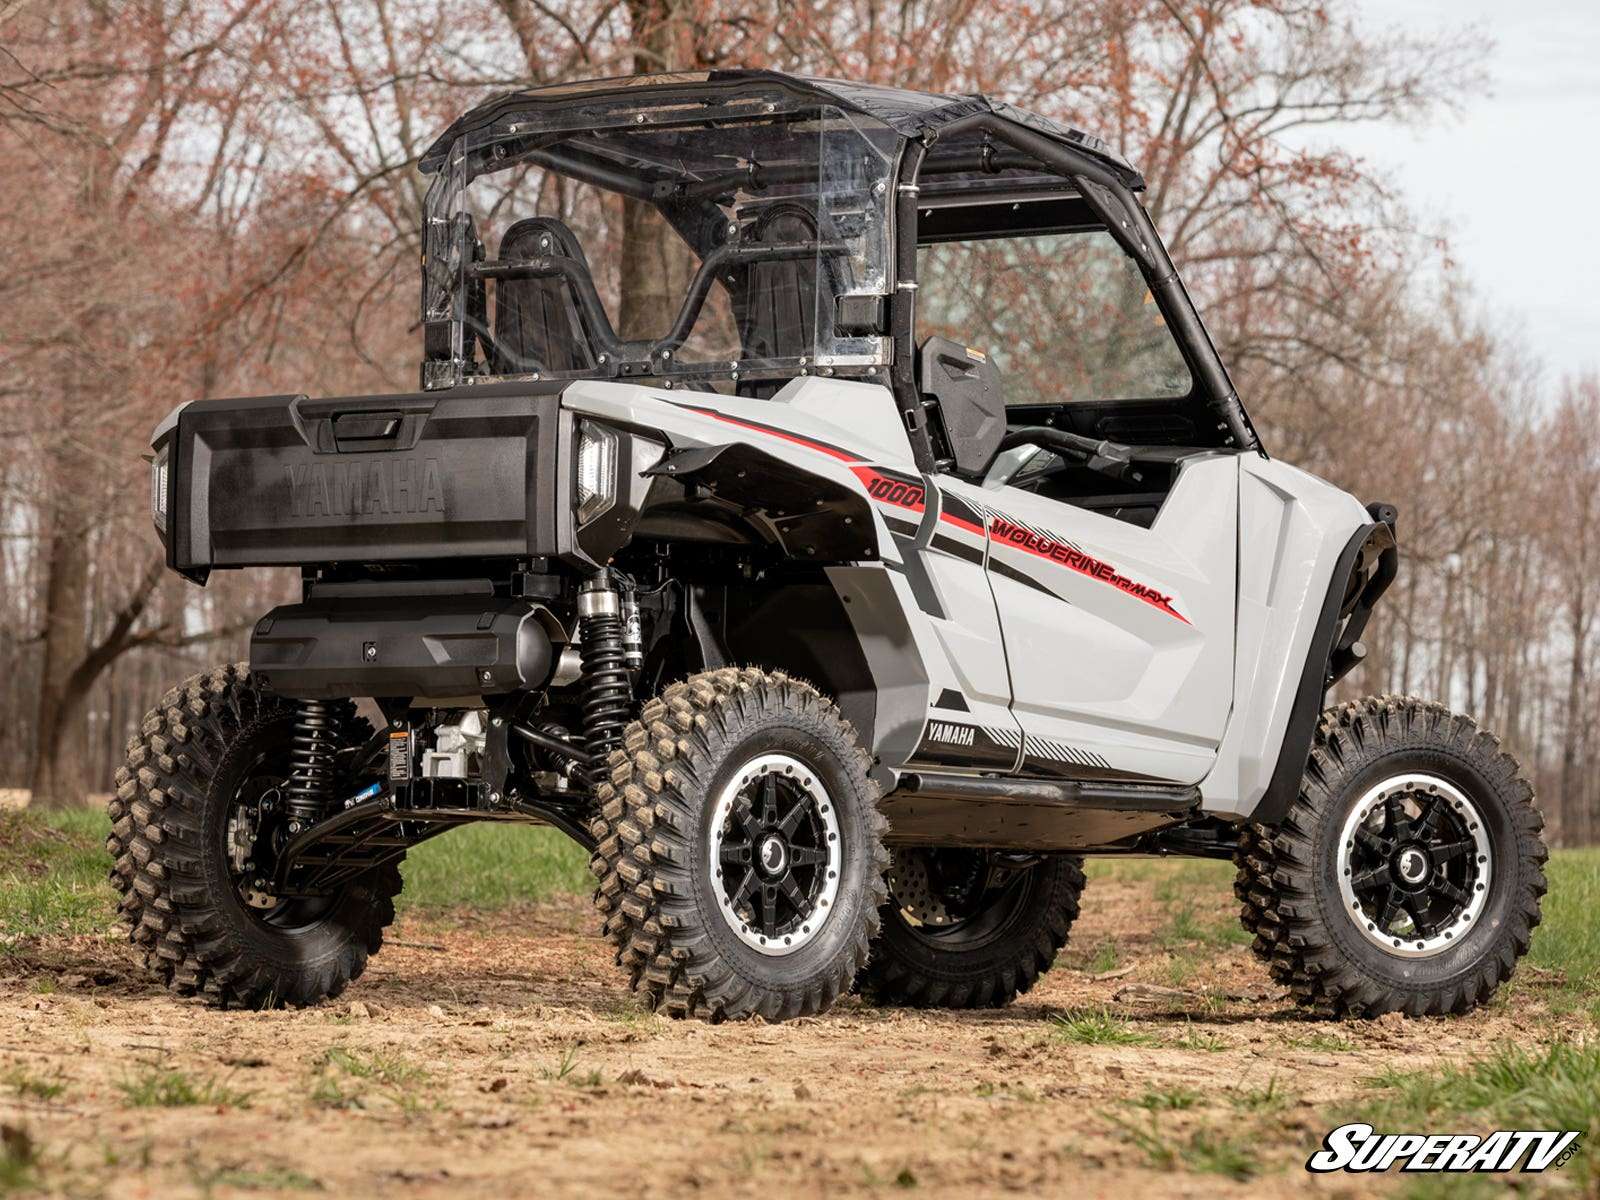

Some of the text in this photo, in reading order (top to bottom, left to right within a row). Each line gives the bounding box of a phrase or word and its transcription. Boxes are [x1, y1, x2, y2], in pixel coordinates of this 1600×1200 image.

[284, 457, 446, 518] YAMAHA
[868, 478, 921, 507] 1000
[991, 518, 1115, 581] WOLVERINE
[928, 721, 976, 746] YAMAHA
